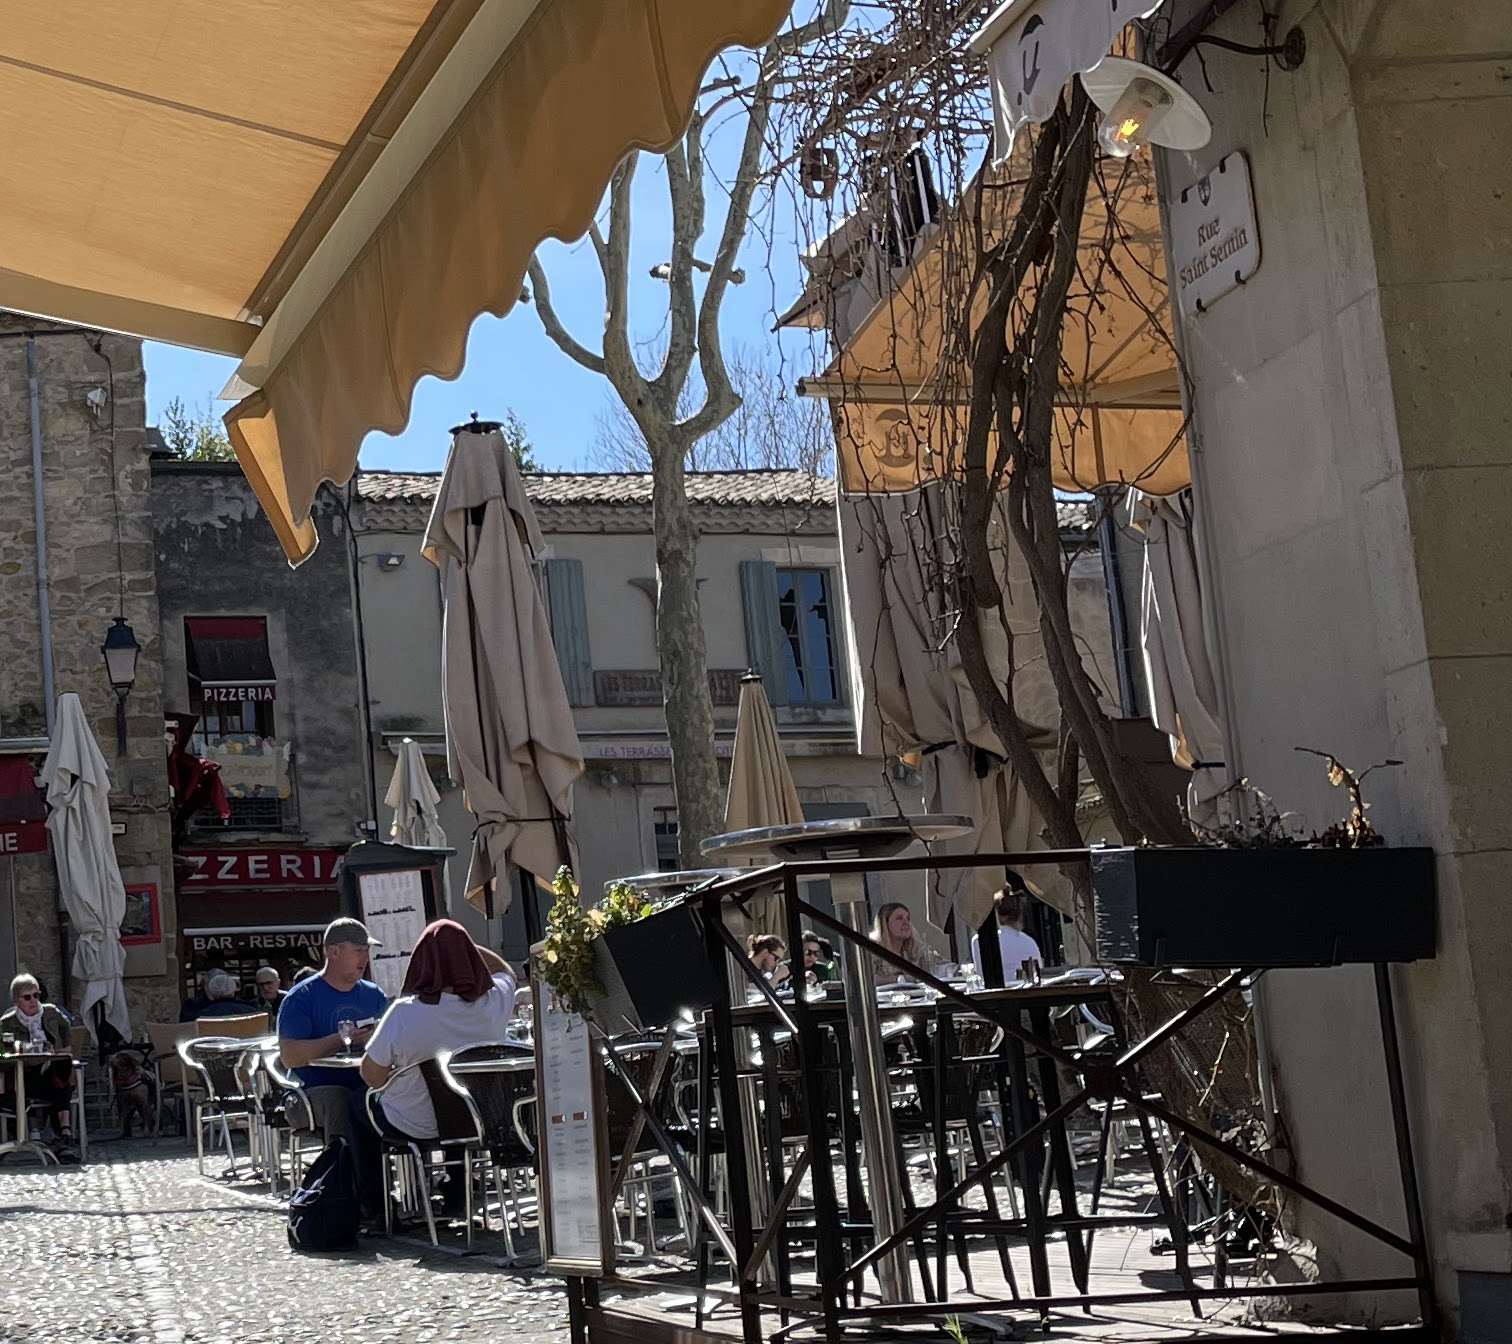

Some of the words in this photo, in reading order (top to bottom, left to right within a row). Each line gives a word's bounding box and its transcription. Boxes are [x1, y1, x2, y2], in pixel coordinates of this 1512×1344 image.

[1197, 217, 1221, 248] Rue
[1179, 254, 1210, 289] Saint
[203, 687, 274, 702] PIZZERIA
[193, 936, 234, 951] BAR
